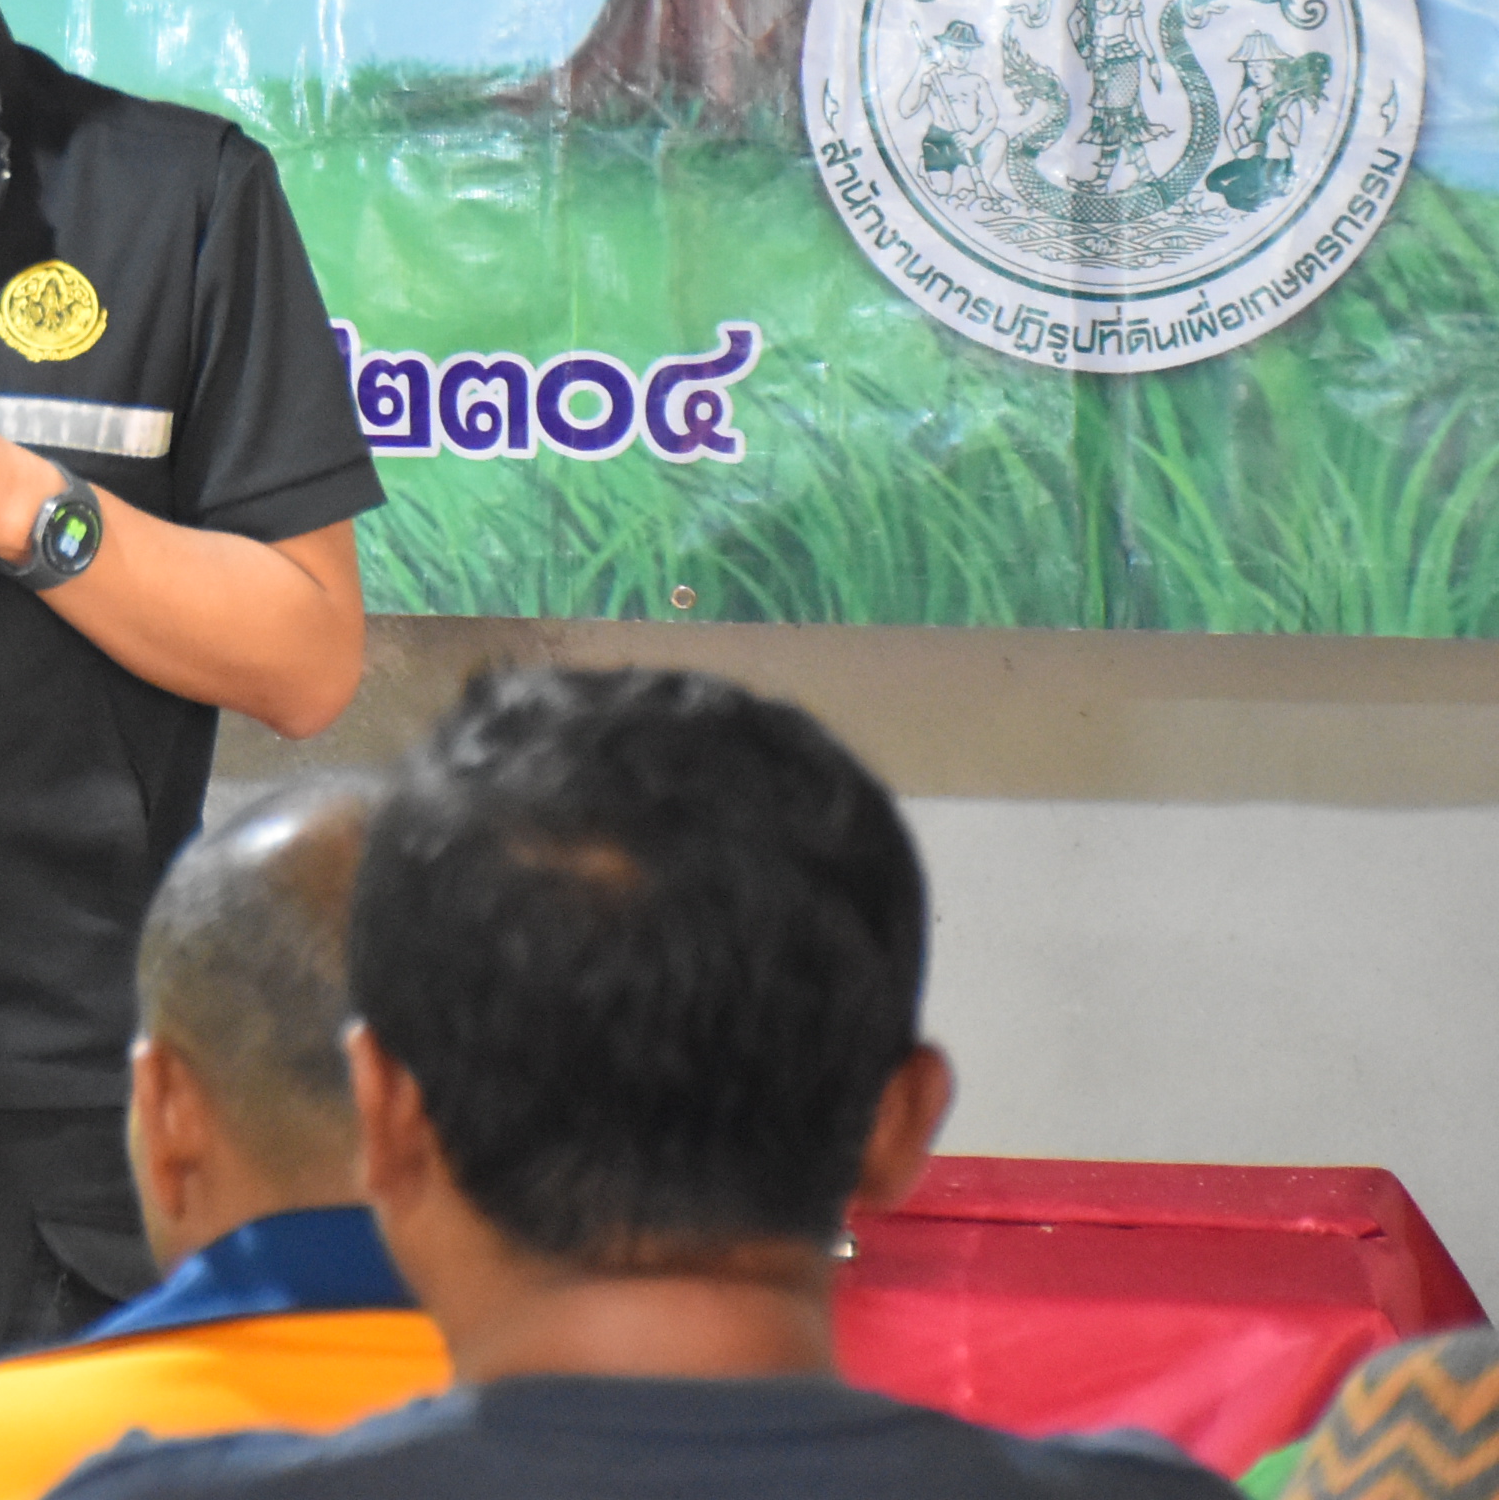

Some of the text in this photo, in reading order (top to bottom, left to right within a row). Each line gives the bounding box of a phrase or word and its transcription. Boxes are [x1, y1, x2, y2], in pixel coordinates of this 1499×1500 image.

[820, 138, 1404, 366] สำนักงานการปฏิรูปที่ดินเพื่อเกษตรกรรม
